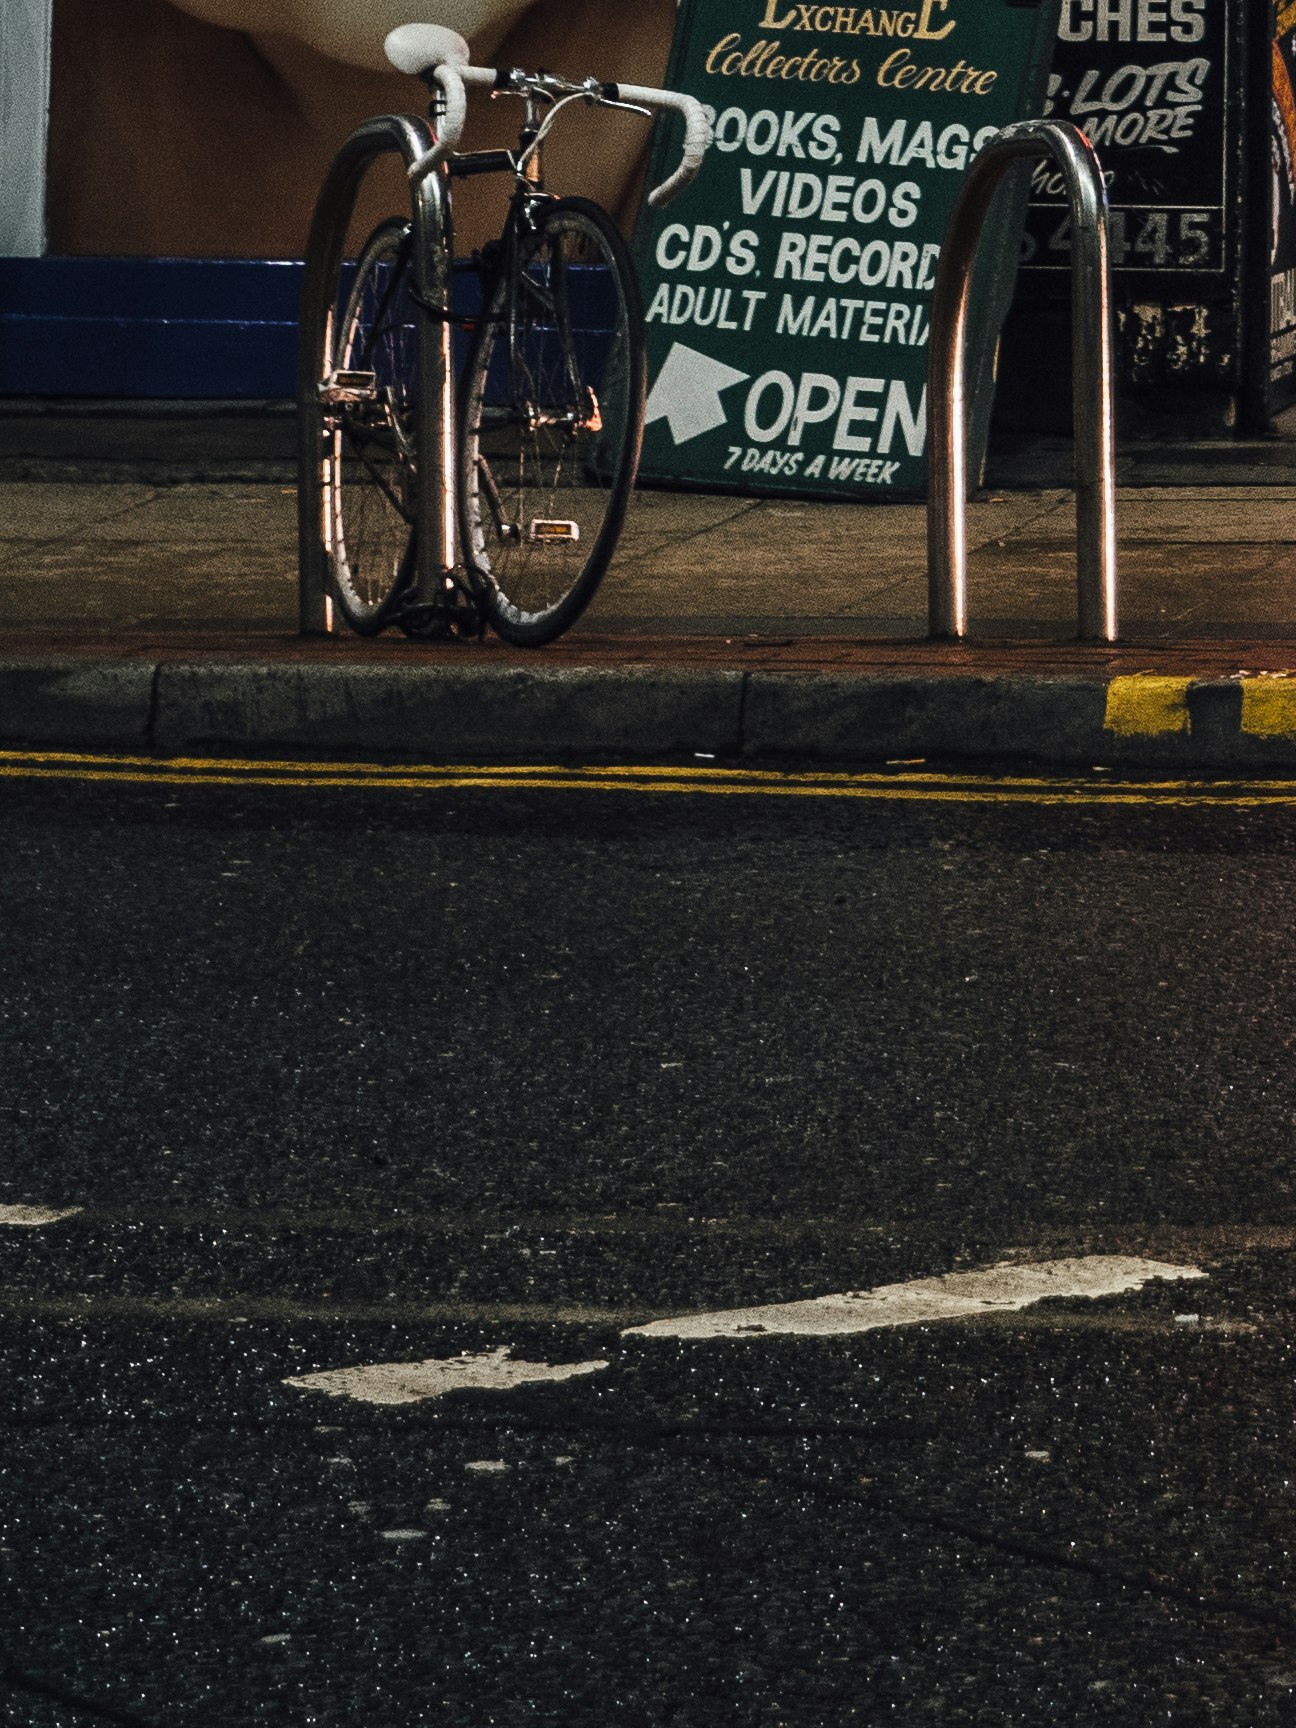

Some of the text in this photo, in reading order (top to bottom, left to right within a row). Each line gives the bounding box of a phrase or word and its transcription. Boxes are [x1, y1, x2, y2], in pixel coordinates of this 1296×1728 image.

[704, 32, 998, 96] Collectors Centre
[1069, 58, 1211, 115] LOTS
[1081, 105, 1202, 147] MORE
[740, 168, 923, 229] VIDEOS
[774, 232, 940, 292] RECORD
[645, 284, 767, 332] ADULT
[744, 371, 928, 456] OPEN
[724, 446, 901, 485] 7 DAYS A WEEK
